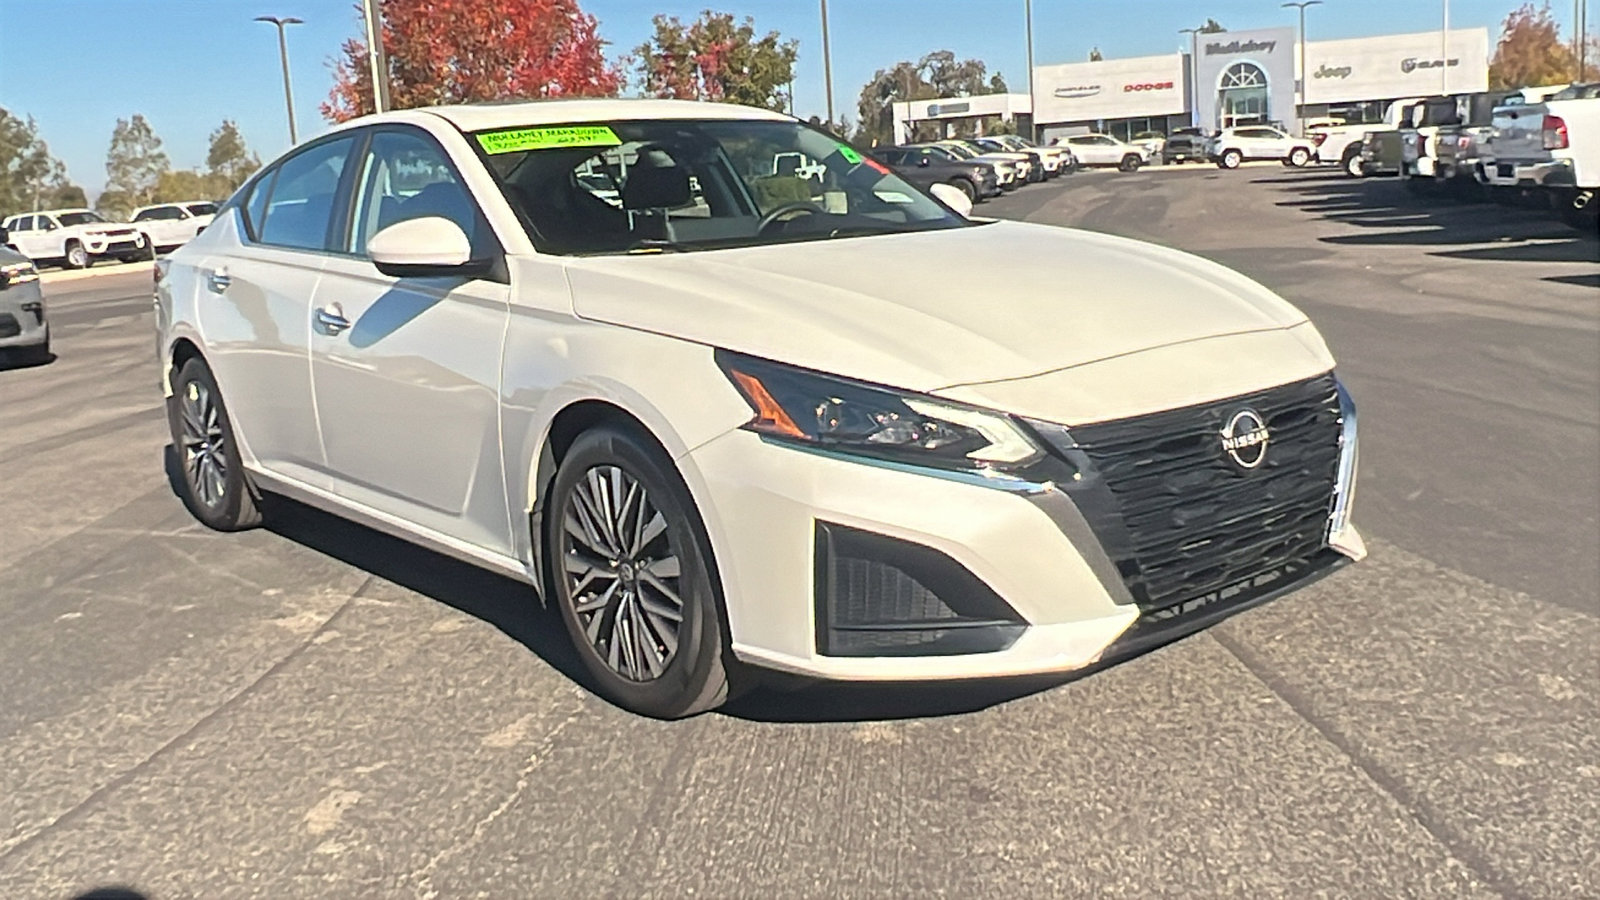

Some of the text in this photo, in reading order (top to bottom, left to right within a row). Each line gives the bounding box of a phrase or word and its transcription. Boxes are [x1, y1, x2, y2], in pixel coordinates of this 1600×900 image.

[1314, 64, 1352, 79] Jeep
[1123, 82, 1173, 93] DODGE
[1221, 429, 1269, 451] NISSAN
